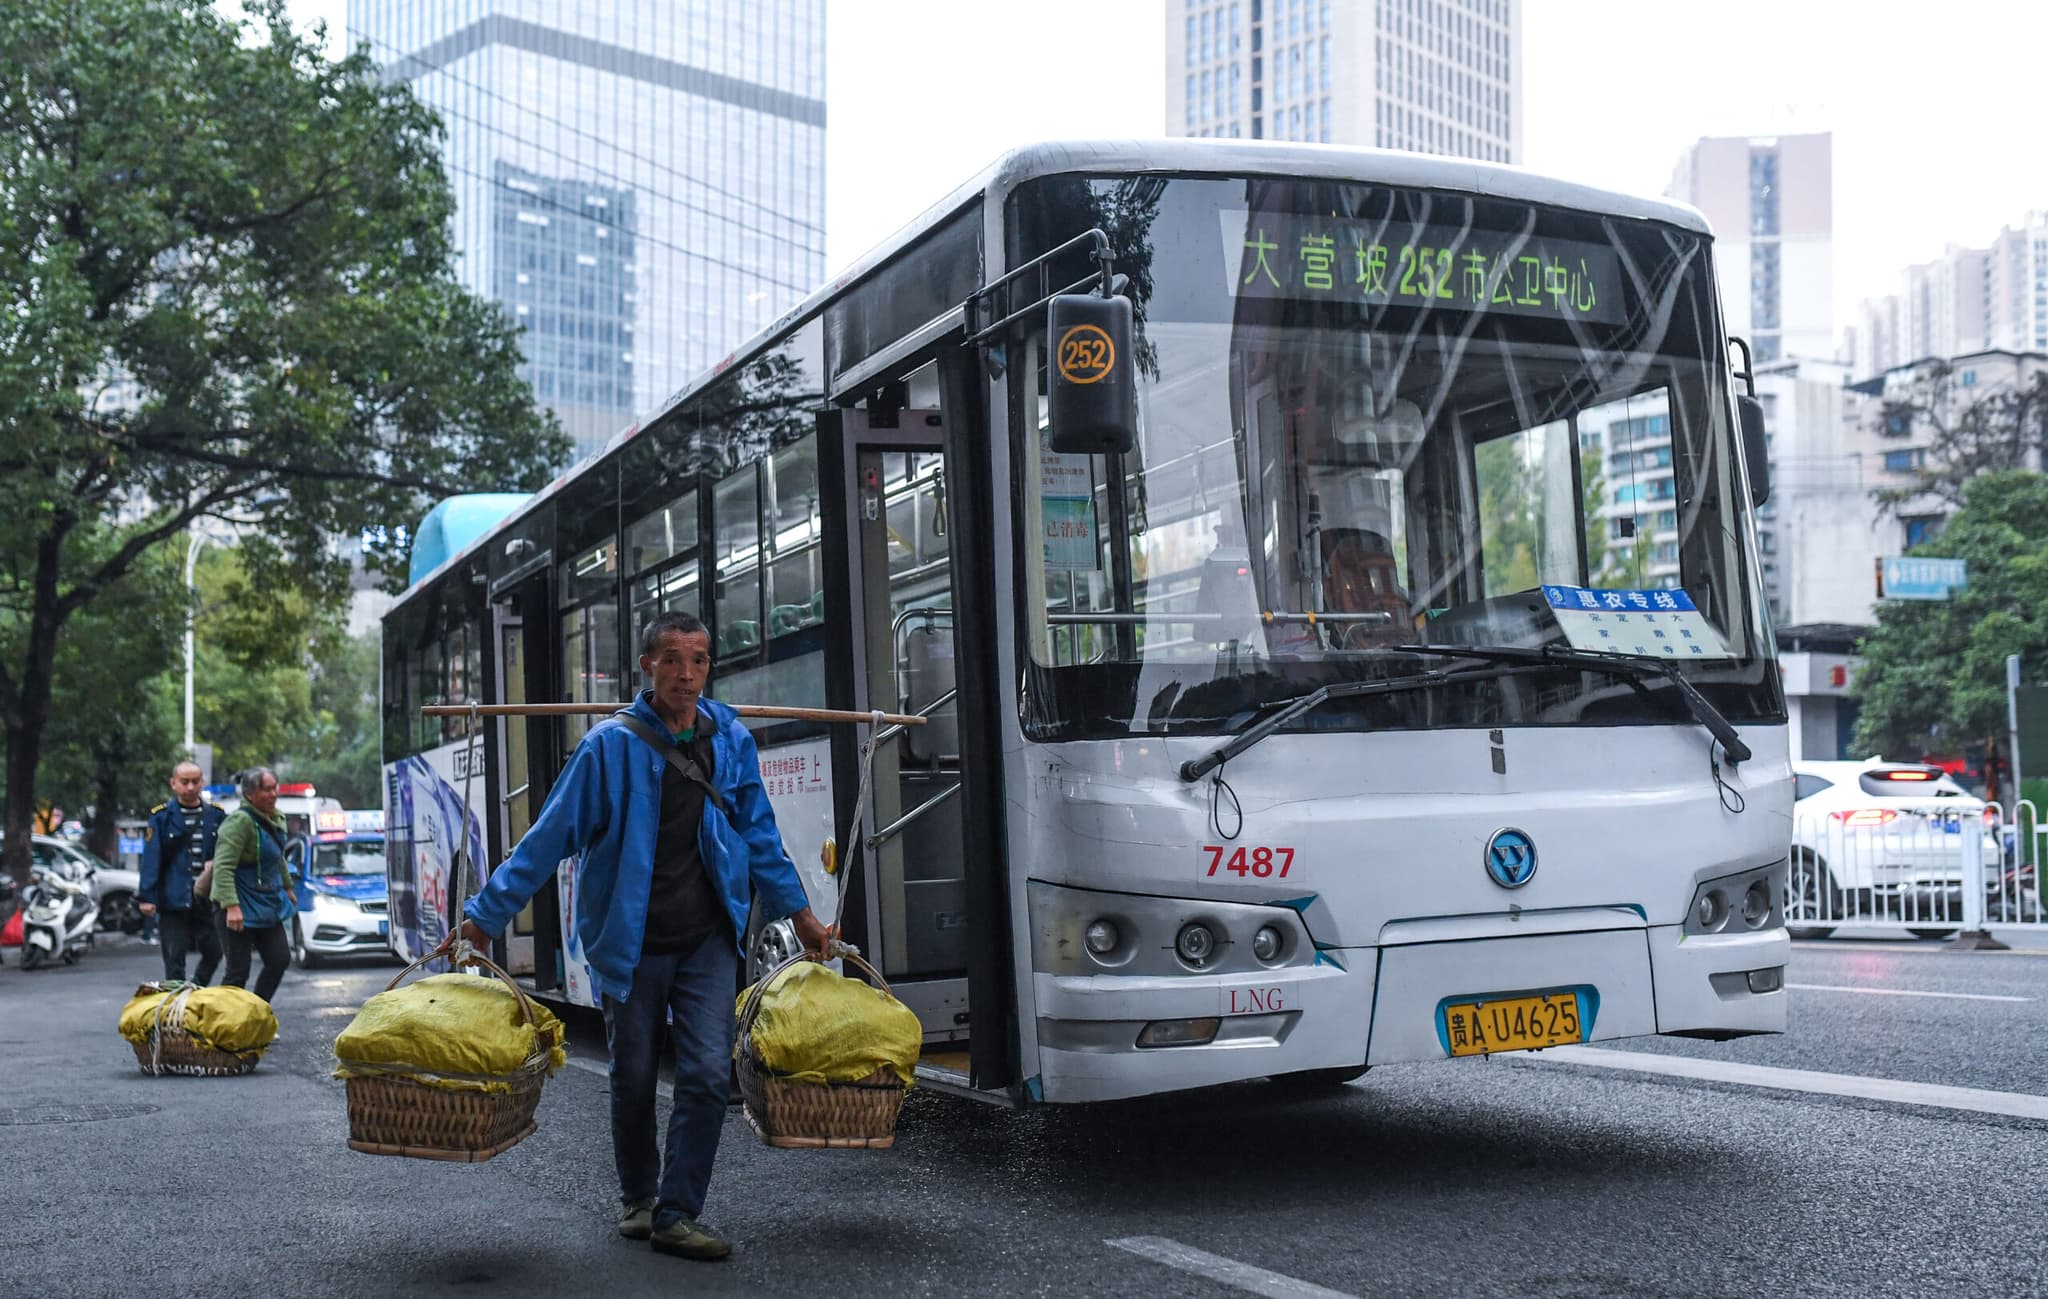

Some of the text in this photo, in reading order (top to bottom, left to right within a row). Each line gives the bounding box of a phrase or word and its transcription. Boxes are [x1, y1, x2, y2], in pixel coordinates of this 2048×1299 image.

[1244, 229, 1596, 313] 大营坡 252 市公卫中心
[1065, 340, 1106, 369] 252
[1576, 591, 1678, 609] 惠农专线
[810, 753, 822, 783] 上
[1203, 845, 1295, 878] 7487
[1229, 988, 1284, 1013] LNG
[1451, 1000, 1577, 1048] 贵A·U4625
